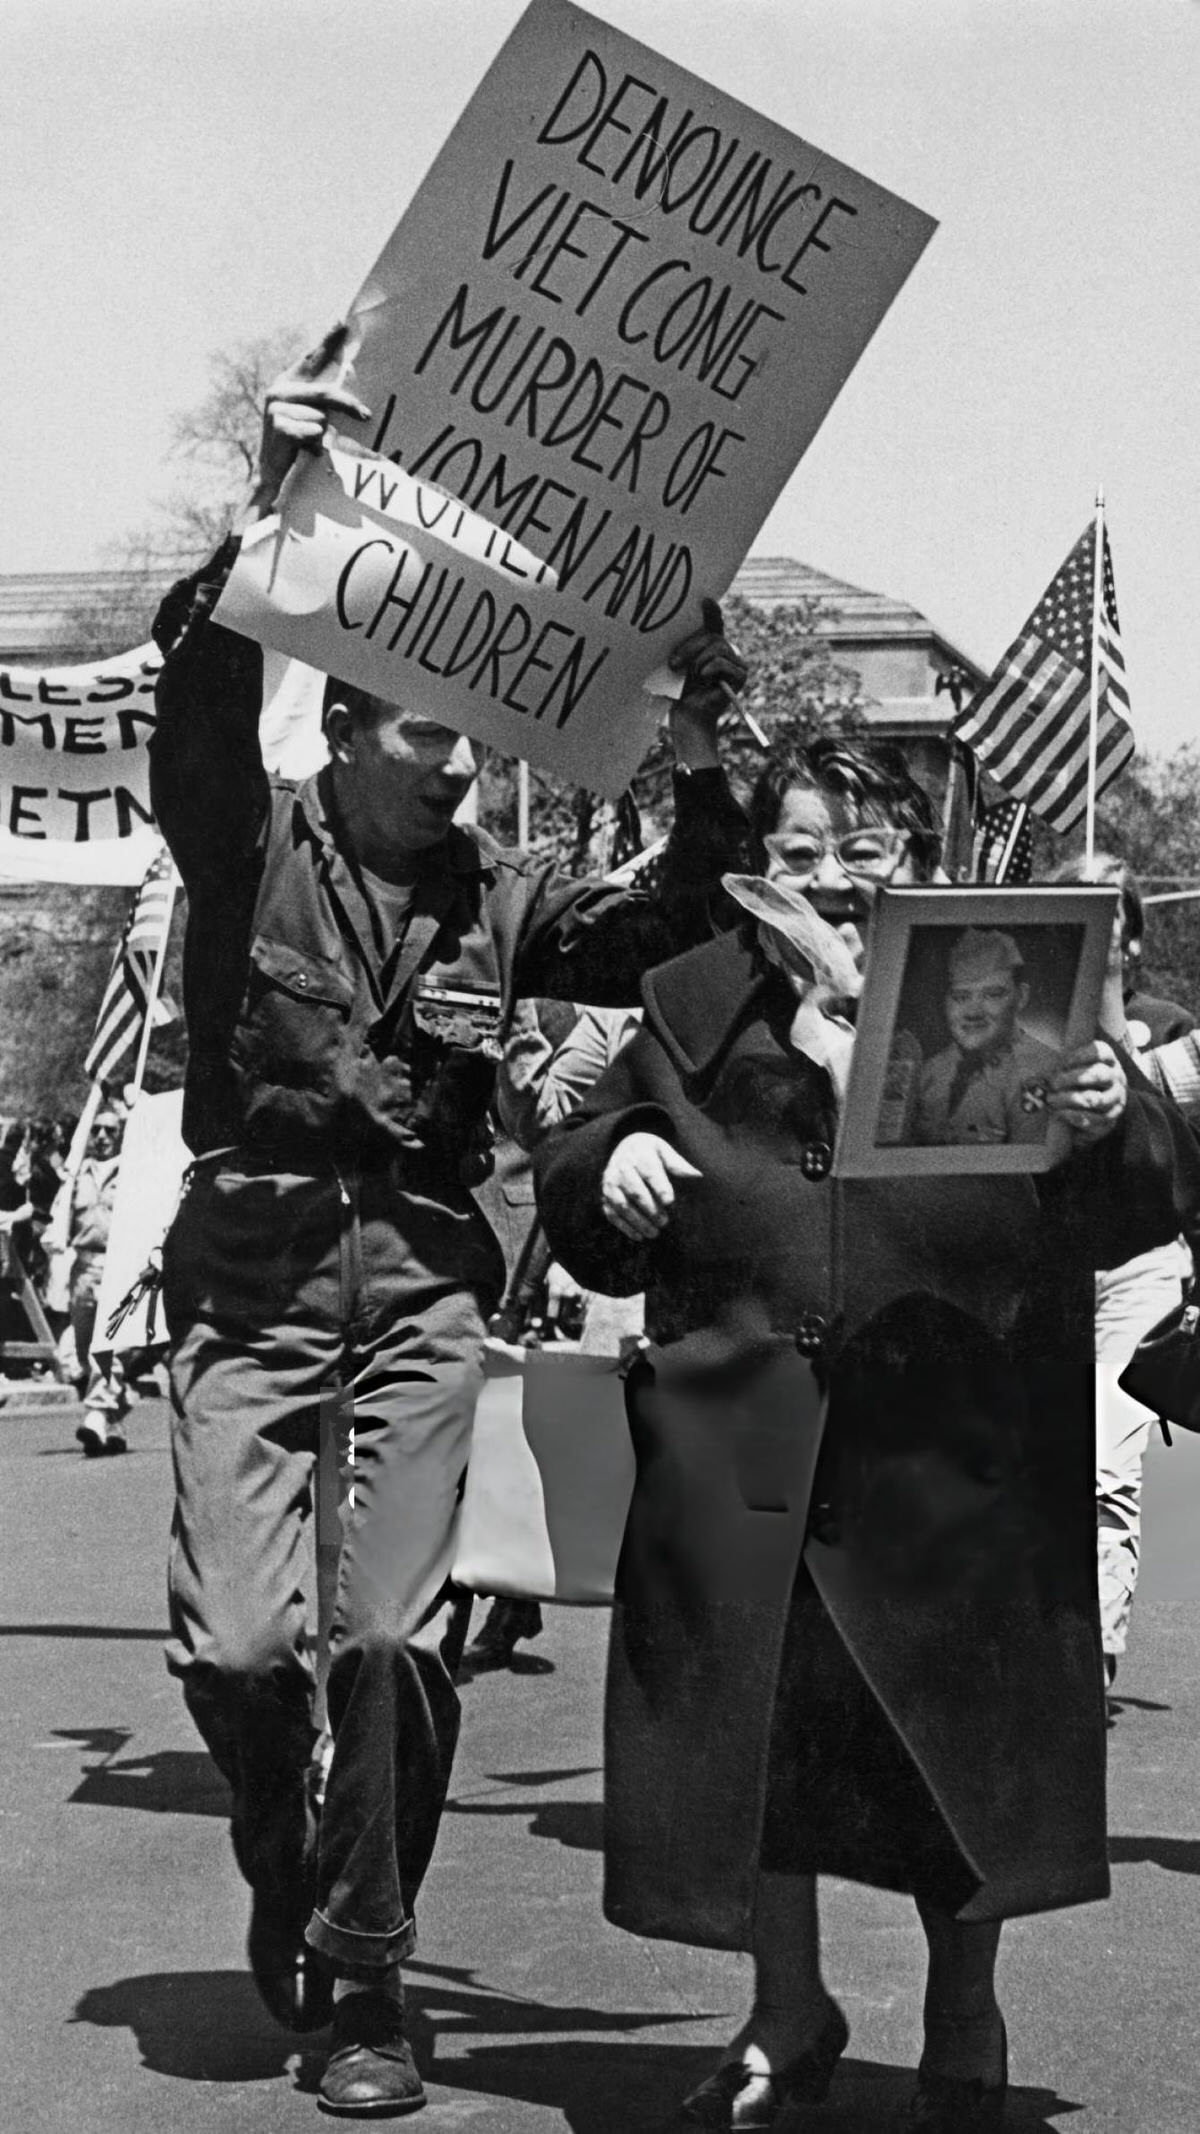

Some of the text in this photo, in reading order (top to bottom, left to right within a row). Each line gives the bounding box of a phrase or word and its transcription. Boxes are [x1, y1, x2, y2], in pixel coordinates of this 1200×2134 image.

[483, 159, 786, 400] VIET CONG
[537, 49, 858, 295] DENOUNCE
[355, 394, 693, 632] WOMEN AND
[414, 284, 746, 513] MURDER OF
[336, 539, 609, 728] CHILDREN
